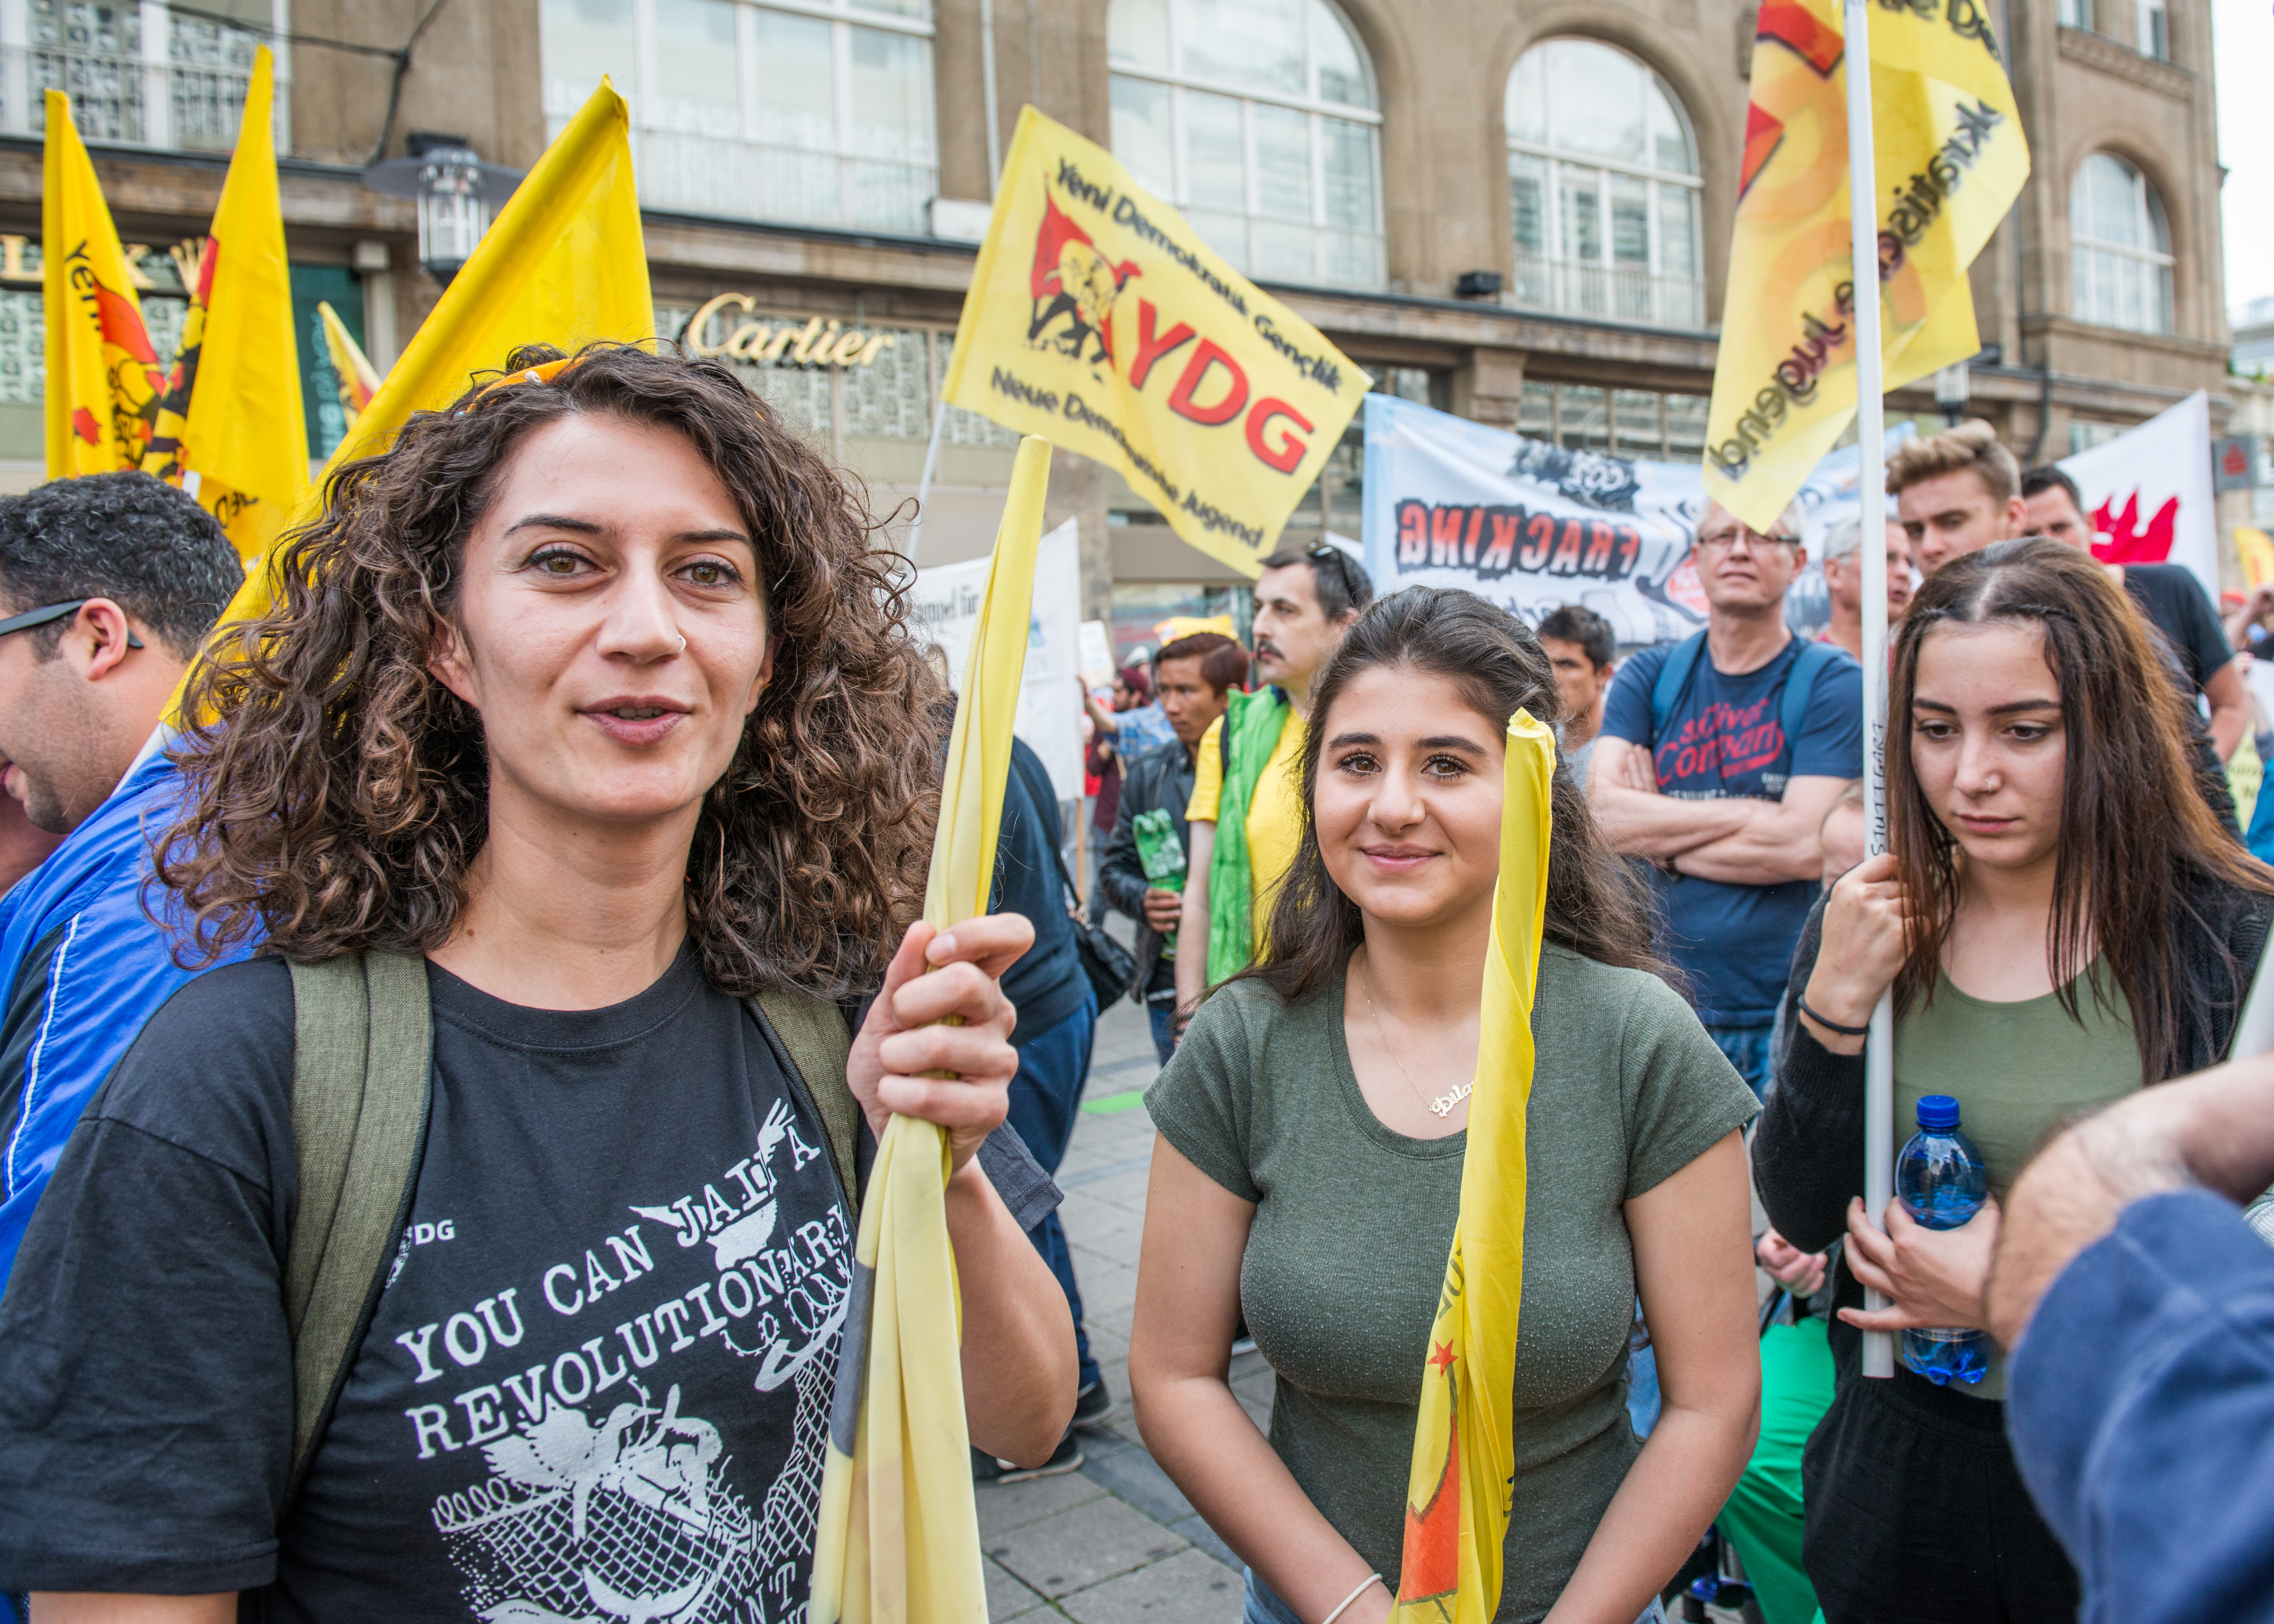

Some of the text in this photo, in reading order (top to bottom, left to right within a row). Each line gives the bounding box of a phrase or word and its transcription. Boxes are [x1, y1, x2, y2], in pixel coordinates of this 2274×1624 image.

[687, 292, 895, 367] Cartier
[1057, 157, 1345, 396] Yeni Demokratik Gençlik
[990, 366, 1060, 415] Neue
[1182, 491, 1265, 550] Jugend
[1128, 297, 1315, 475] YDG
[1429, 1080, 1474, 1117] Dila
[395, 1287, 524, 1384] YOU
[542, 1224, 656, 1316] CAN
[786, 1125, 821, 1171] A
